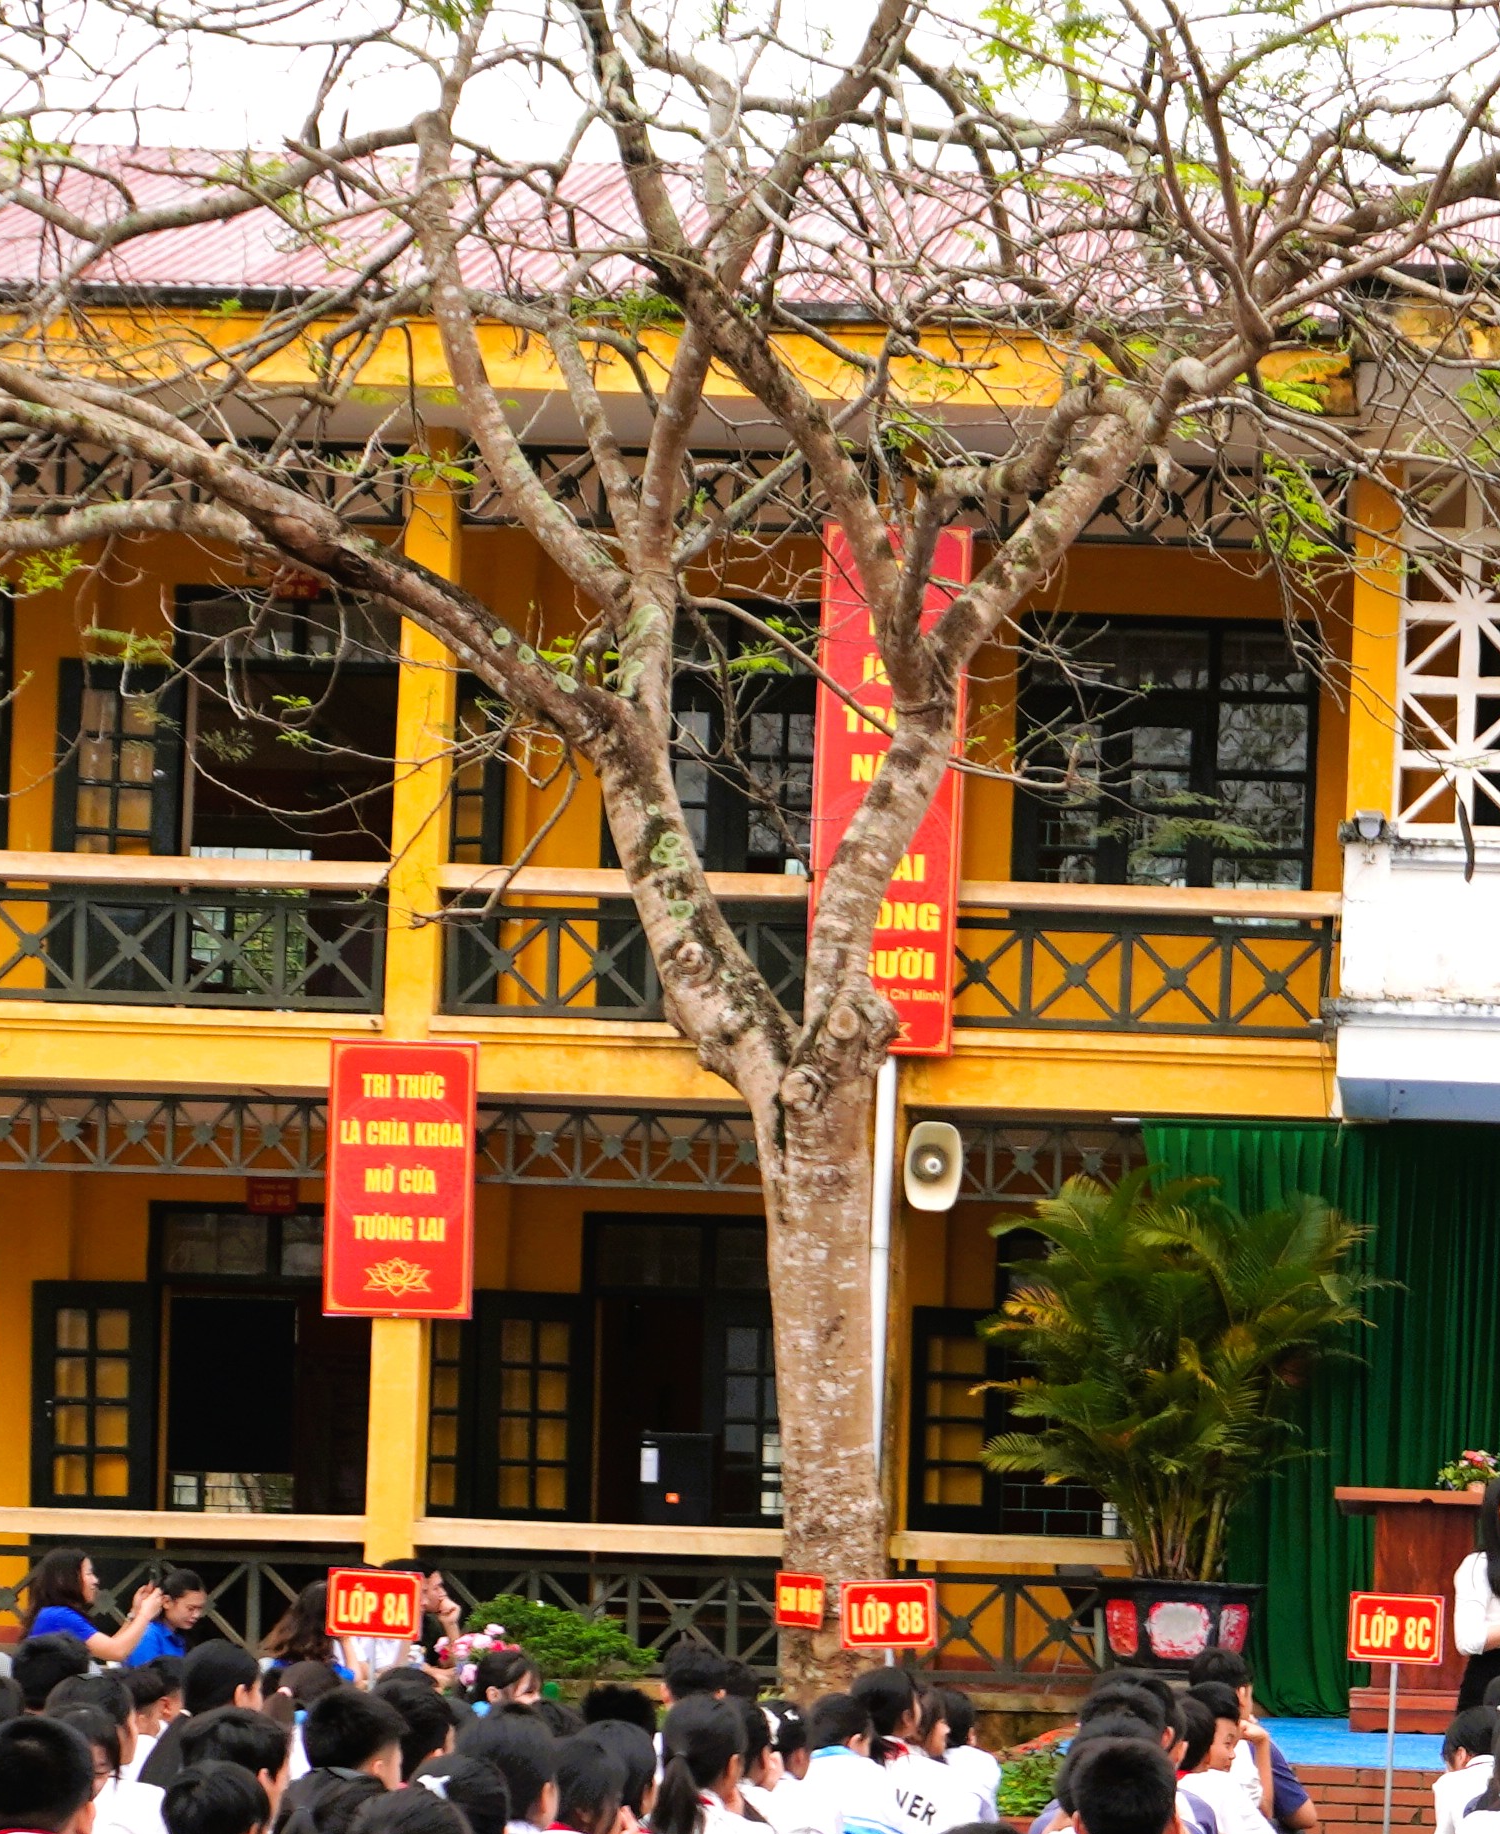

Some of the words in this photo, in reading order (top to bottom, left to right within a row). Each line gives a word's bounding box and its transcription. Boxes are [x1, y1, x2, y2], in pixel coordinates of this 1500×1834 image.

[362, 1073, 391, 1098] TRI
[396, 1071, 446, 1100] THỨC
[340, 1116, 361, 1145] LÀ
[366, 1117, 409, 1146] CHÌA
[414, 1119, 463, 1148] KHÓA
[353, 1212, 414, 1241] TƯƠNG
[418, 1217, 446, 1242] LAI
[338, 1580, 378, 1624] LỚP
[383, 1592, 409, 1627] 8A
[850, 1596, 891, 1634] LỚP
[897, 1602, 924, 1633] 8B
[1359, 1606, 1398, 1648] LỚP
[1404, 1617, 1431, 1648] 8C
